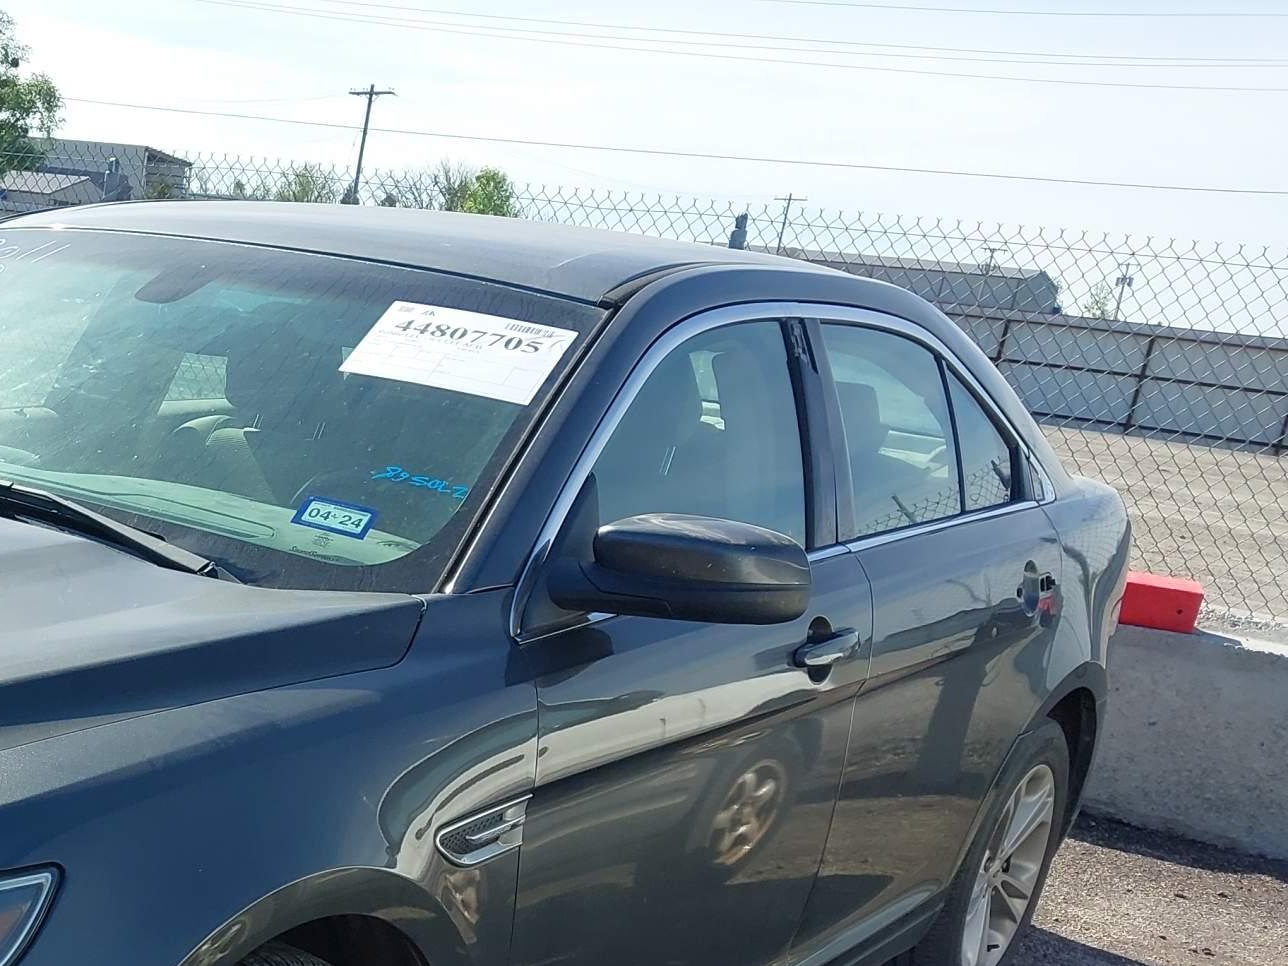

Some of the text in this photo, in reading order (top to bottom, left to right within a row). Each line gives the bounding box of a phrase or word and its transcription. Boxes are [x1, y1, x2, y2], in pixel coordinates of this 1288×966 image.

[394, 318, 546, 354] 44807705
[307, 506, 330, 522] 04
[338, 513, 364, 530] 24
